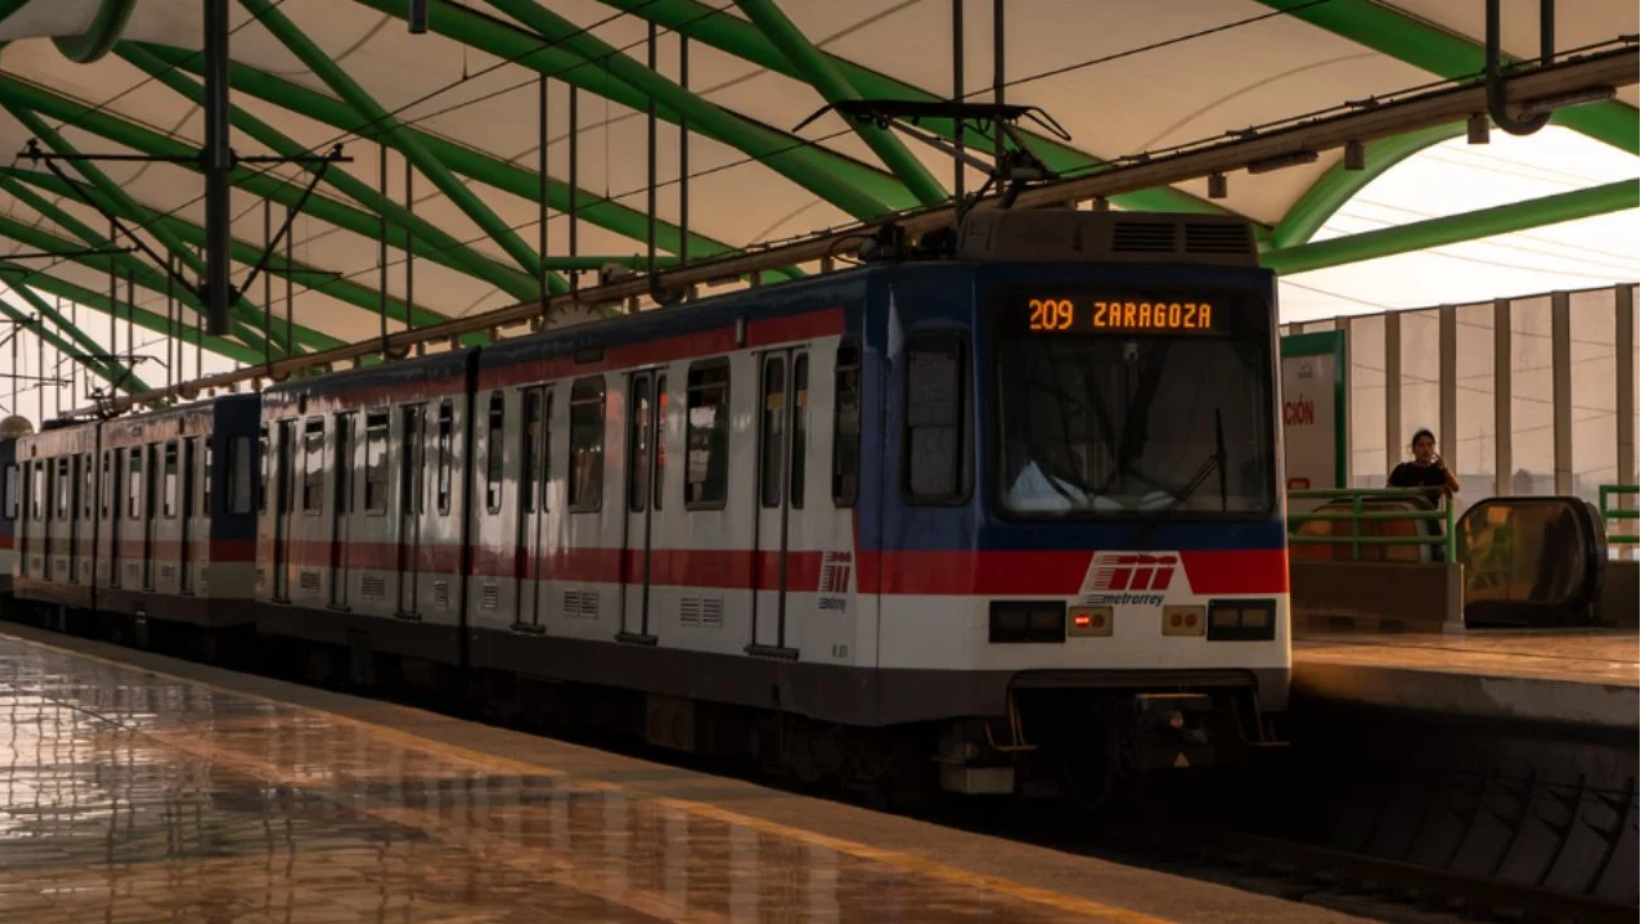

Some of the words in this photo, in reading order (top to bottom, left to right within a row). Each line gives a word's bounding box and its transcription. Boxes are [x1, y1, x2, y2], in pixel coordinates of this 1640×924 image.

[1029, 299, 1074, 330] 209
[1093, 302, 1211, 328] ZARAGOZA
[1284, 393, 1314, 425] CIÓN
